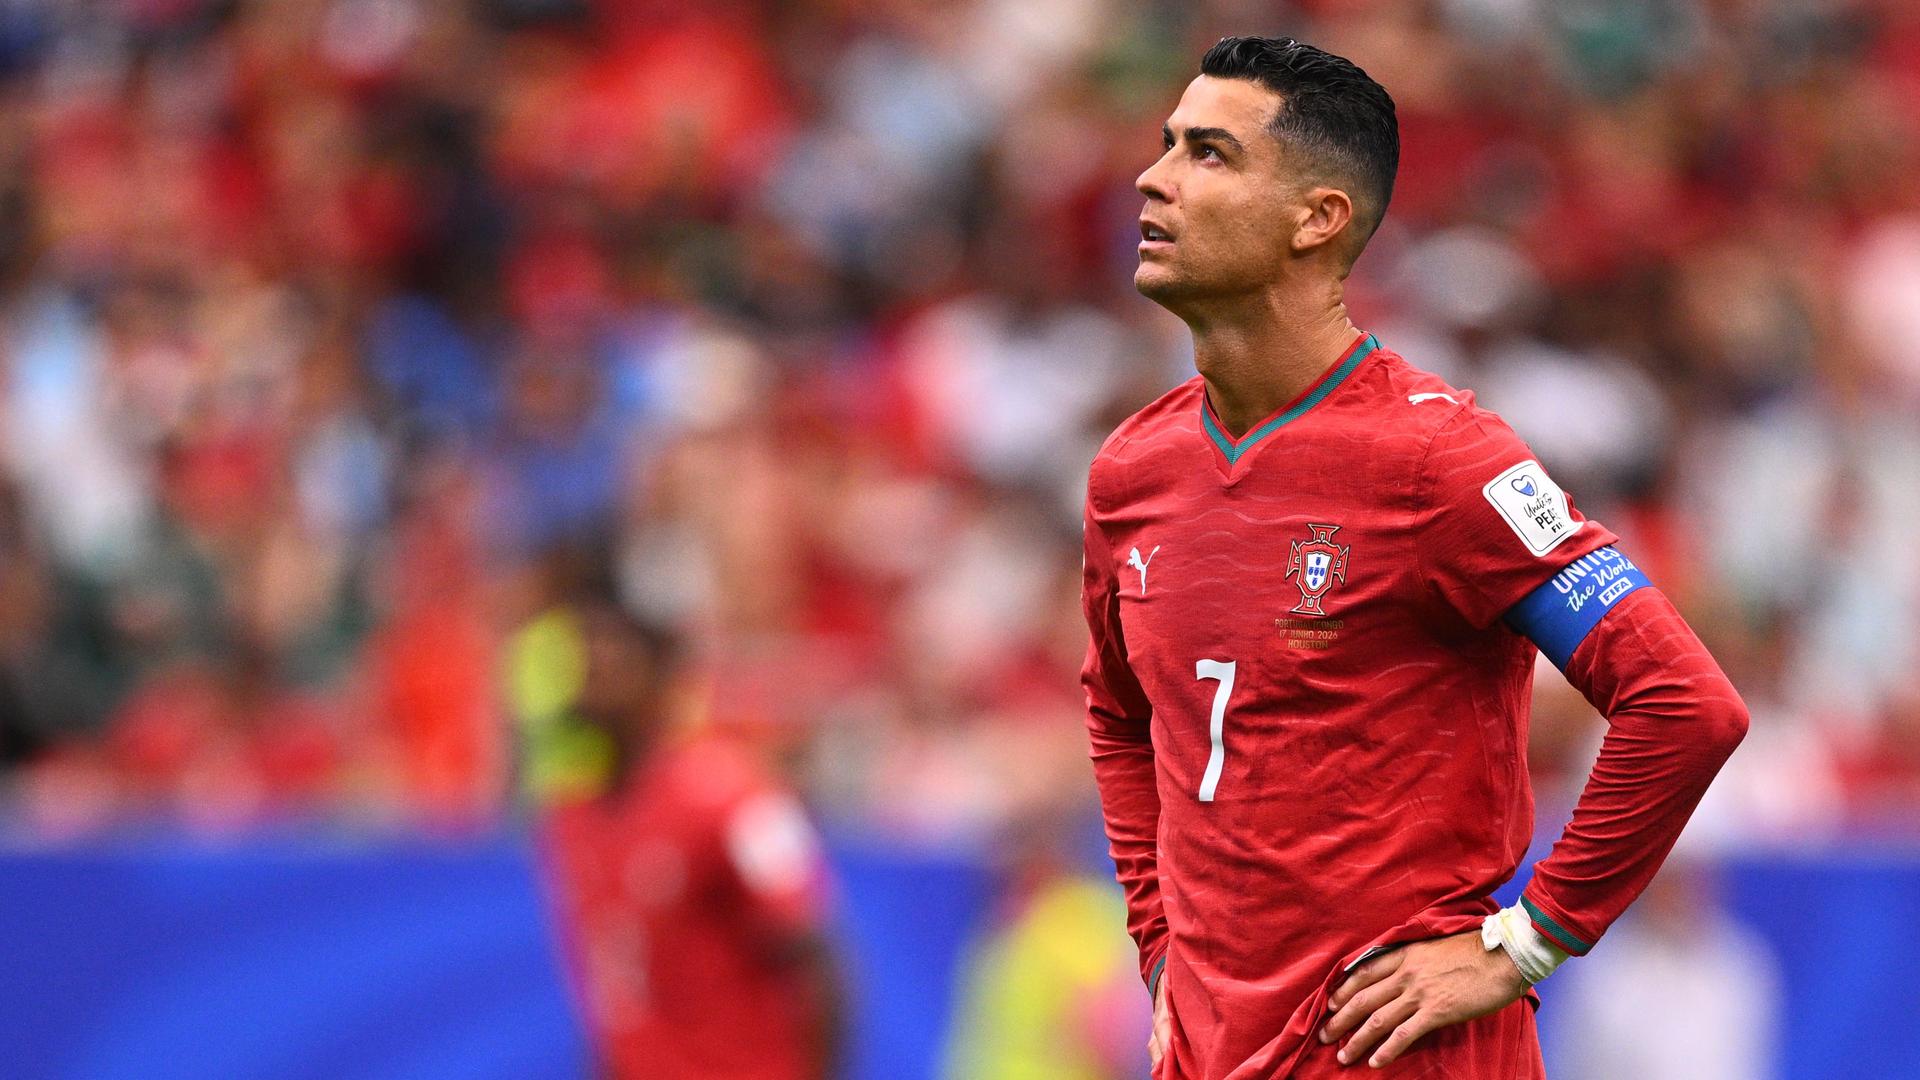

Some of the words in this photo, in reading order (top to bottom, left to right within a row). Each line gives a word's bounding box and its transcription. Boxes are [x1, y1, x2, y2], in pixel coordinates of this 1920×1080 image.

[1535, 508, 1555, 530] PEA
[1551, 522, 1564, 534] FI
[1566, 585, 1595, 612] the
[1591, 557, 1638, 587] World
[1602, 580, 1630, 602] FIFA
[1279, 629, 1287, 639] 17
[1290, 630, 1314, 639] JUNHO
[1317, 630, 1338, 639] 2026
[1288, 639, 1328, 649] HOUSTON
[1195, 658, 1237, 802] 7
